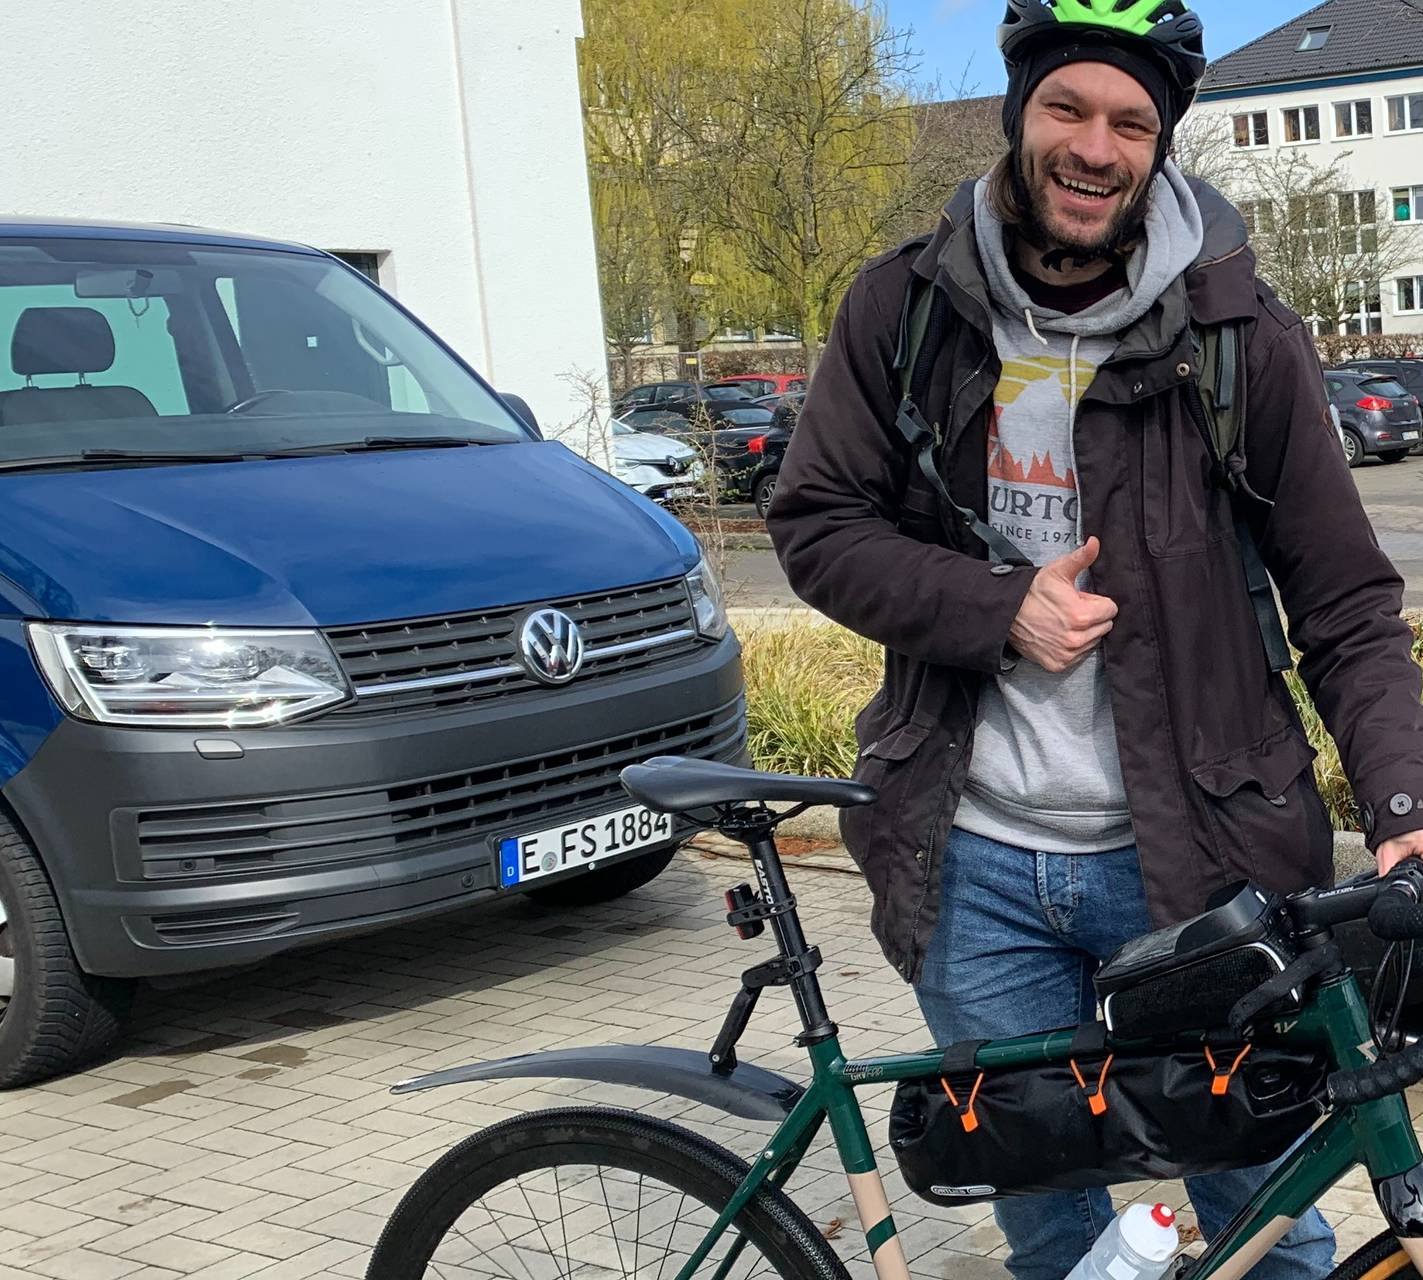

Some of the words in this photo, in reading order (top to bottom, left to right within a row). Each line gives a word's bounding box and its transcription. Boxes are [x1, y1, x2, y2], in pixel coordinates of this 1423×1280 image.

[990, 485, 1078, 521] URTO
[991, 522, 1033, 540] SINCE
[507, 866, 514, 876] D
[521, 839, 540, 875] E
[561, 824, 597, 864] FS
[604, 808, 668, 853] 1884
